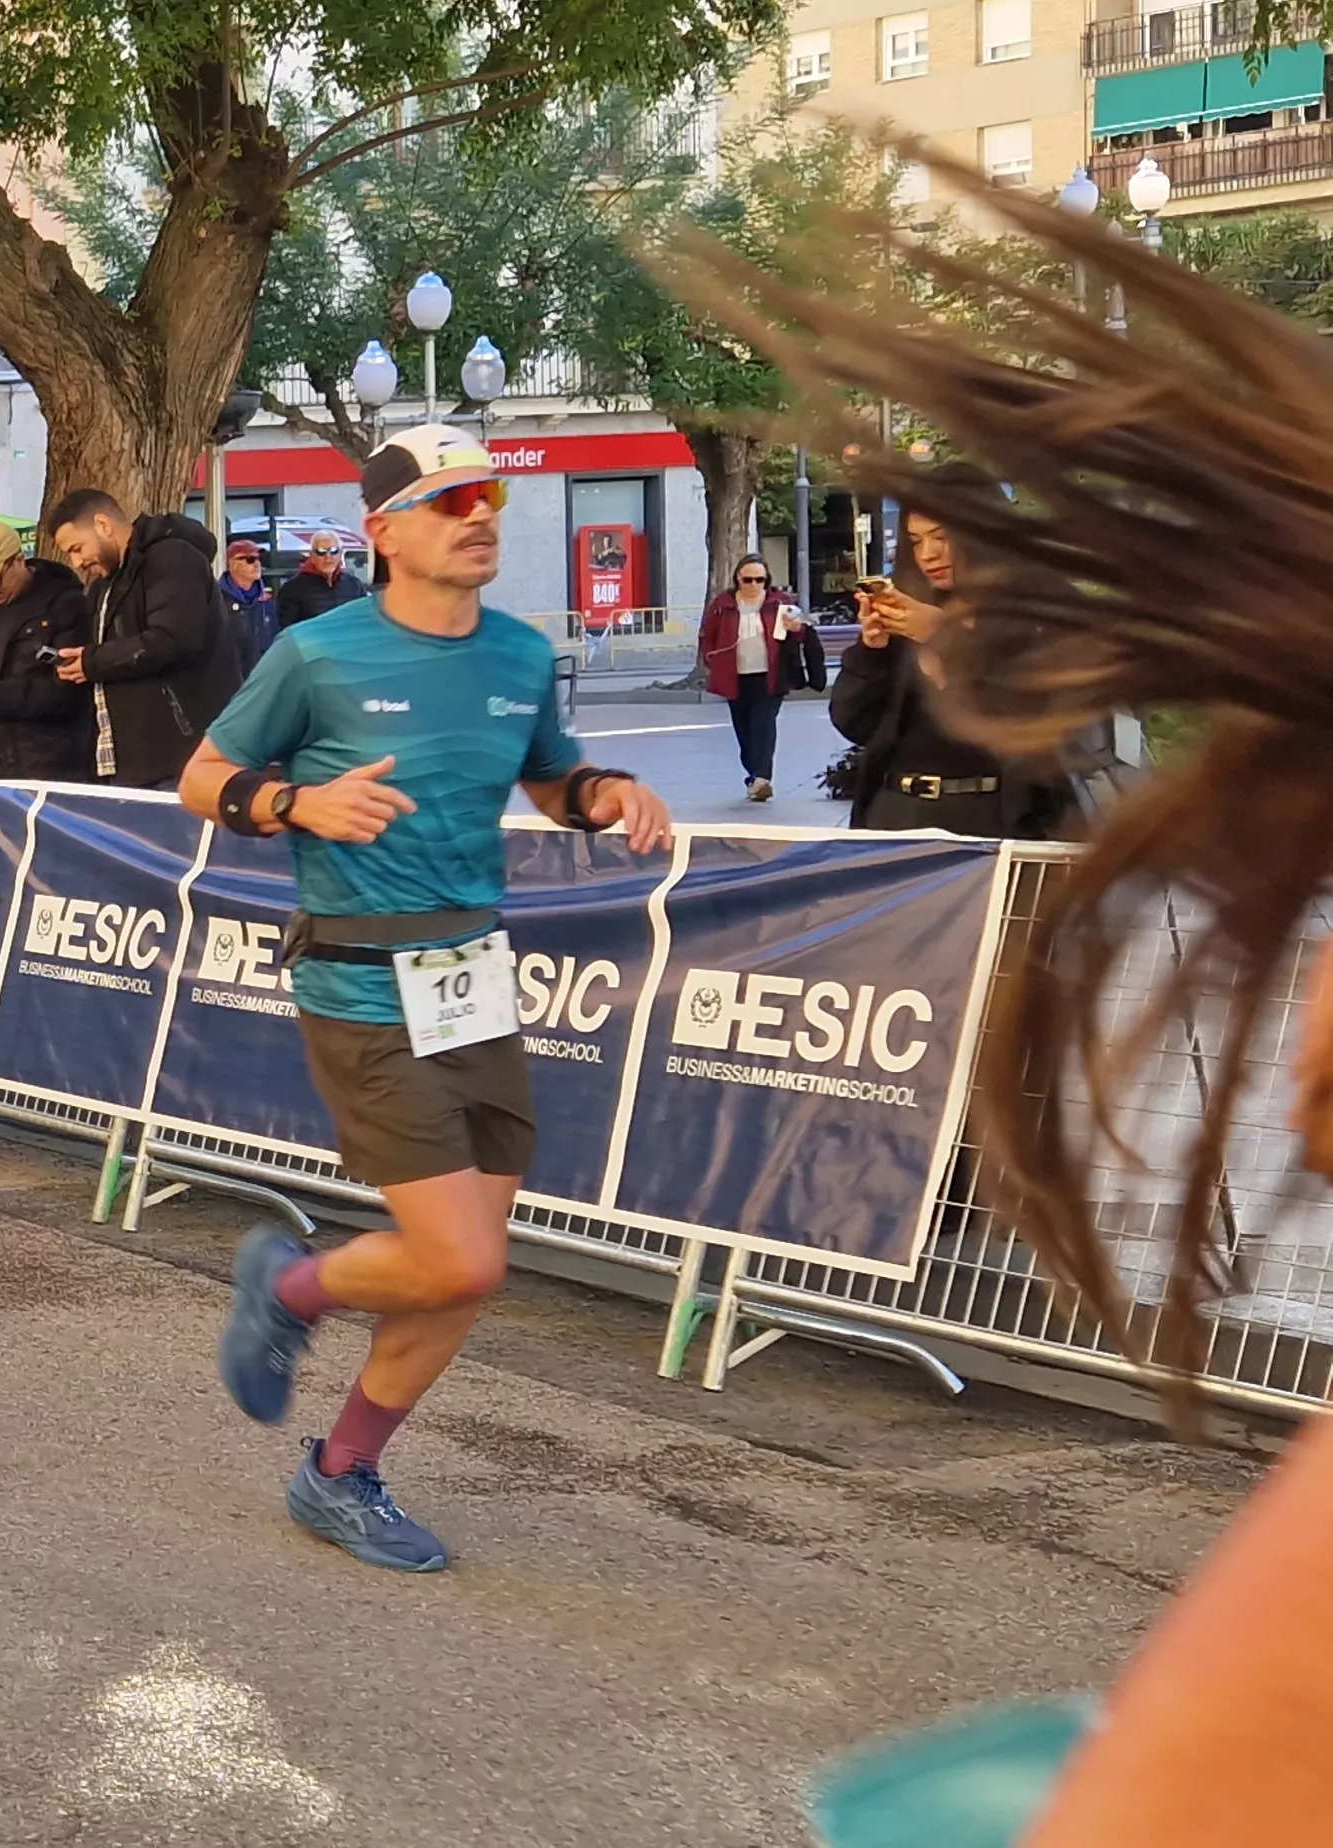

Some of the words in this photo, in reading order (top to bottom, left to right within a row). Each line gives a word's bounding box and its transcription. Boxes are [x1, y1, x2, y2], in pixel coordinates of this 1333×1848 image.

[489, 446, 546, 468] ander
[58, 898, 167, 971] ESIC
[432, 970, 472, 1004] 10
[436, 1003, 476, 1023] JULIO
[510, 950, 621, 1033] SIC
[736, 973, 933, 1073] ESIC
